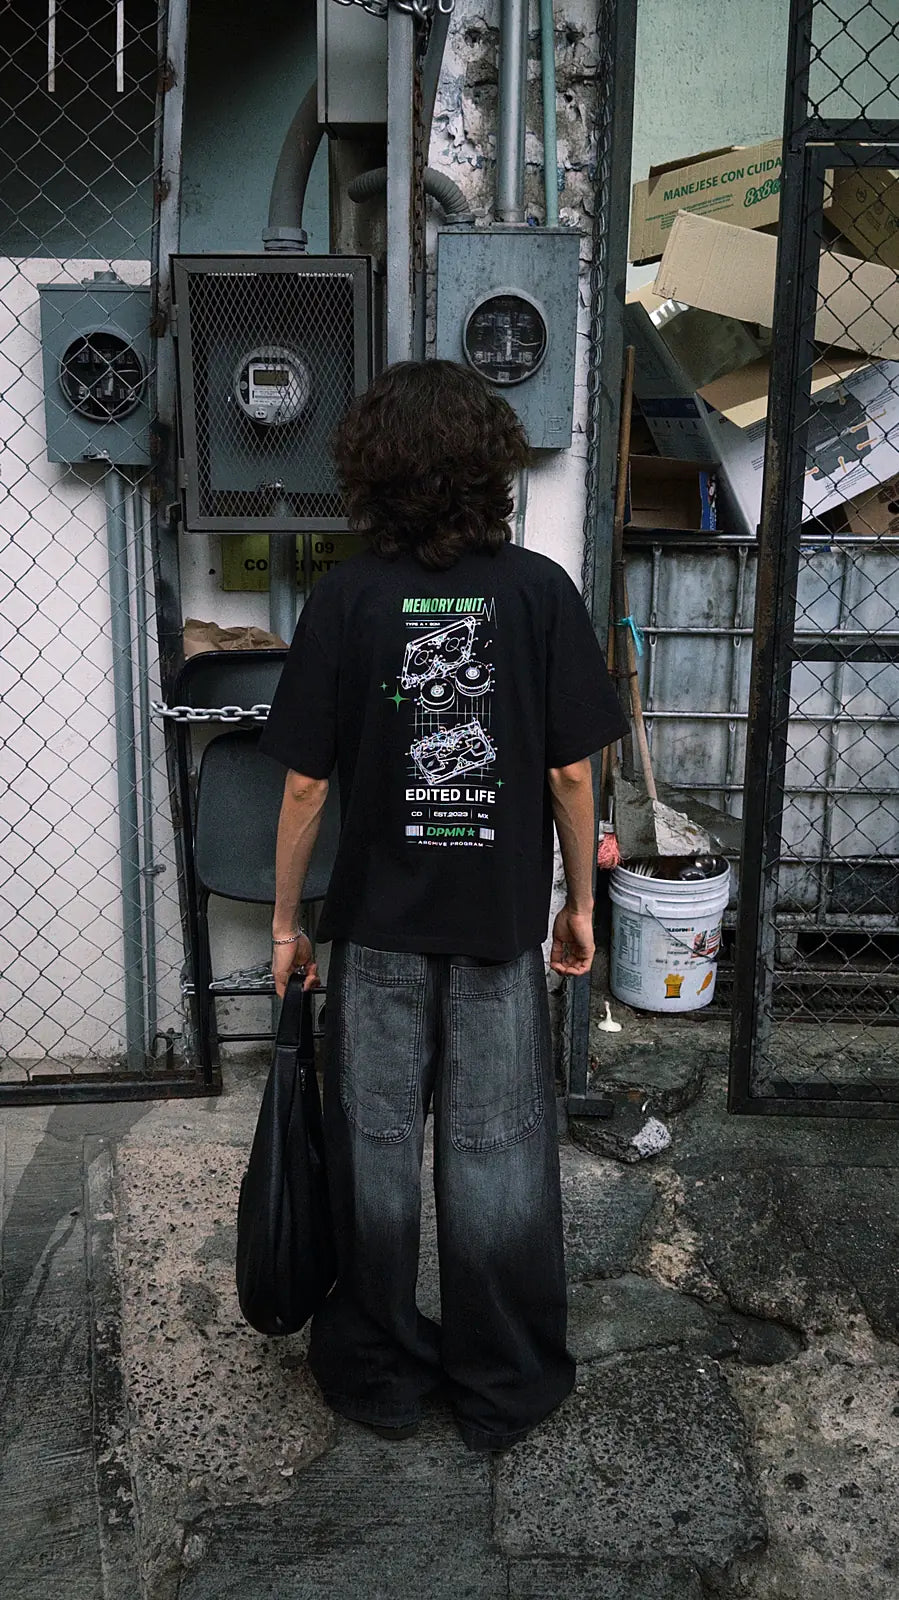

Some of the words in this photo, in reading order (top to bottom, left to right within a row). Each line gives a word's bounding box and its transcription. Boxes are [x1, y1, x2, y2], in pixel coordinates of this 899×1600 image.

[663, 175, 719, 202] MANEJESE
[720, 167, 745, 185] CON
[315, 541, 335, 554] 09
[402, 598, 455, 613] MEMORY
[455, 597, 485, 612] UNIT
[405, 788, 460, 802] EDITED
[465, 788, 496, 804] LIFE
[426, 826, 466, 837] DPMN
